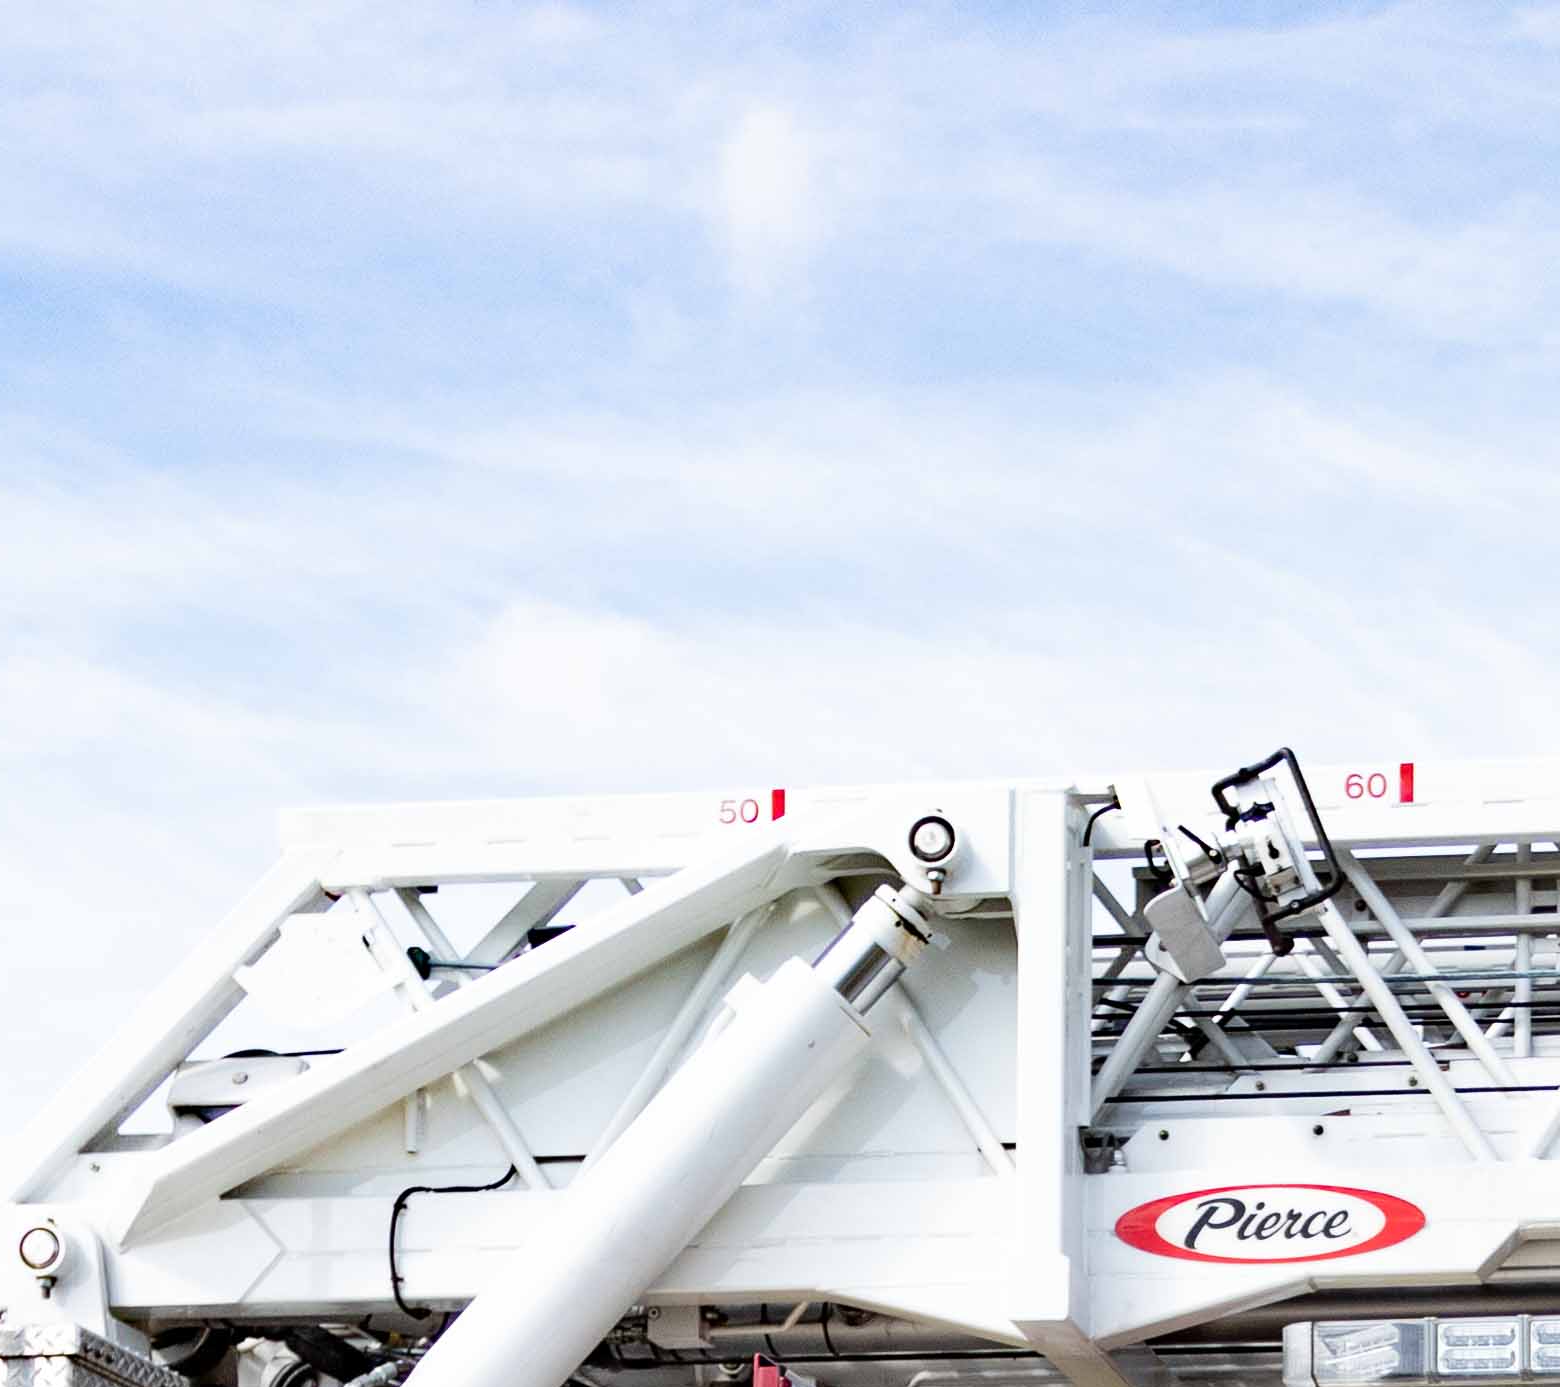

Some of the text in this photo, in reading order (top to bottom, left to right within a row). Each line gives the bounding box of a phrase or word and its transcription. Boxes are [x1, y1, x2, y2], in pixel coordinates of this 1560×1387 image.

[1344, 772, 1388, 800] 60
[718, 799, 761, 825] 50
[1184, 1197, 1353, 1250] Pierce
